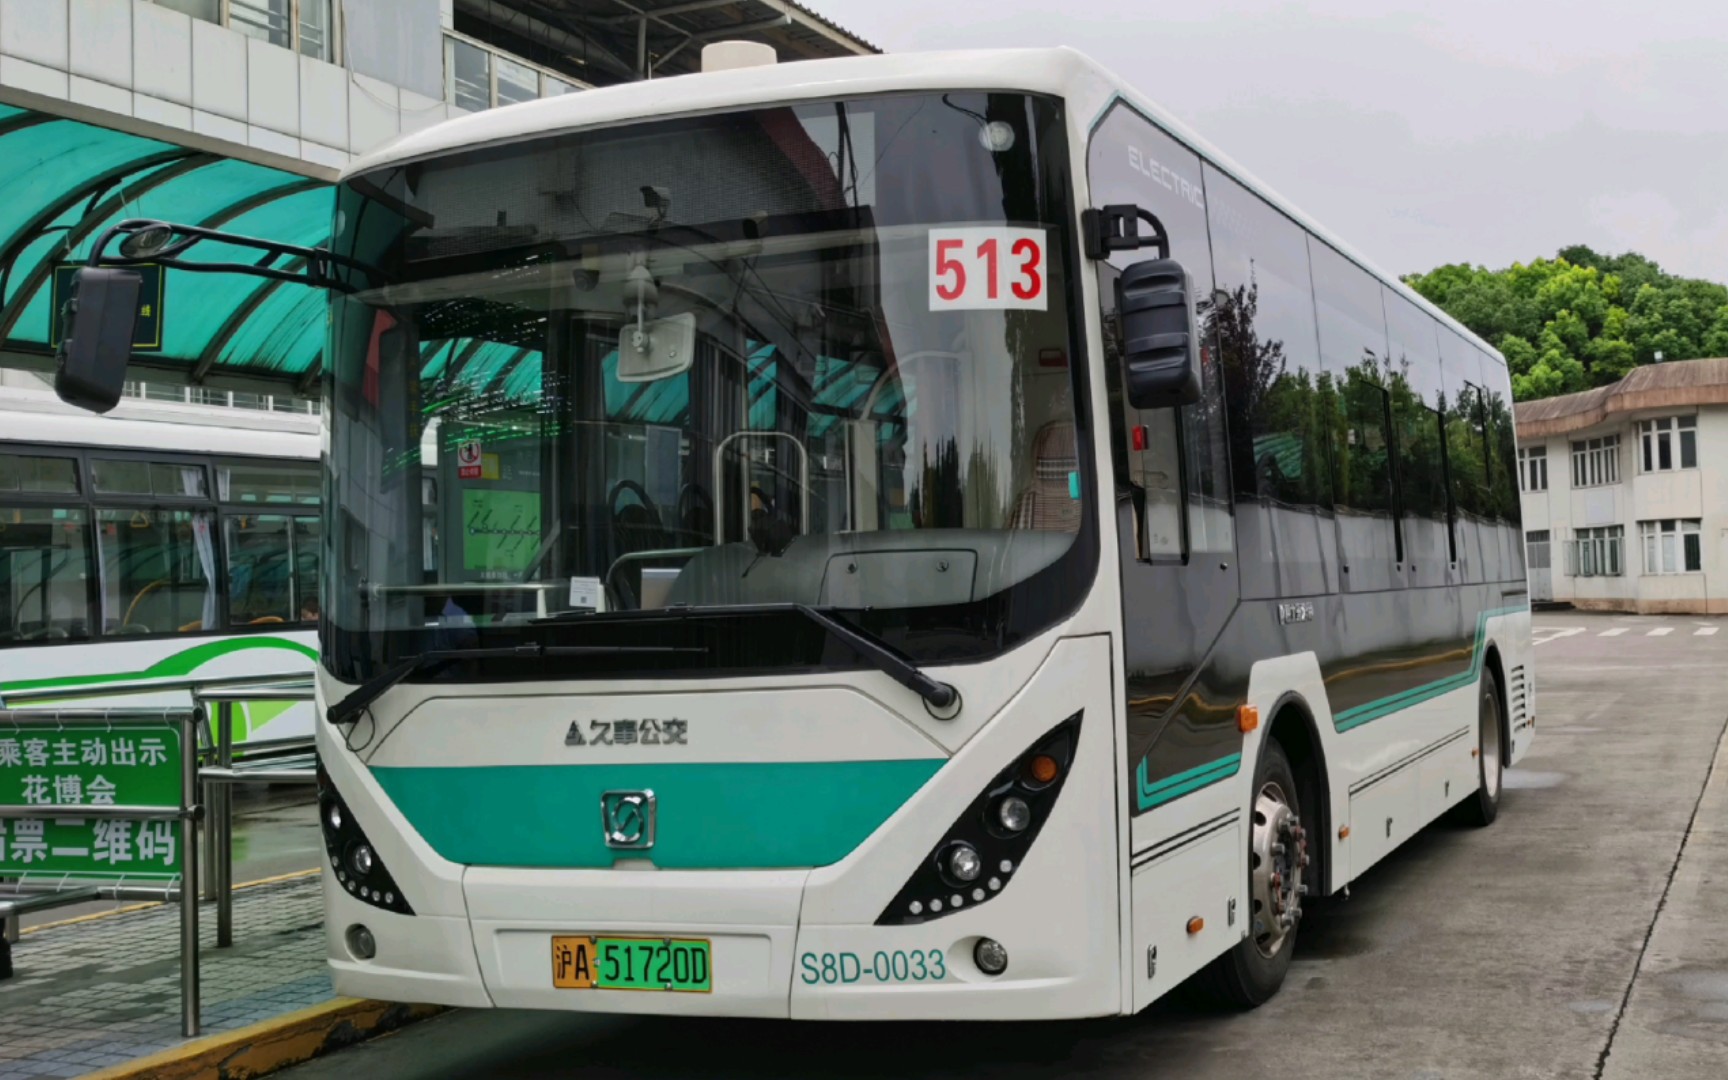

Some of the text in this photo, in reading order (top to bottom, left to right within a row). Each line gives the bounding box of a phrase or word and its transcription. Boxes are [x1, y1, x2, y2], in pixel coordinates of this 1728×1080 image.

[1127, 145, 1204, 209] ELECTRIC
[936, 238, 1042, 300] 513
[0, 737, 167, 767] 乘客主动出示
[21, 774, 116, 805] 花博会
[801, 949, 946, 985] S8D-0033
